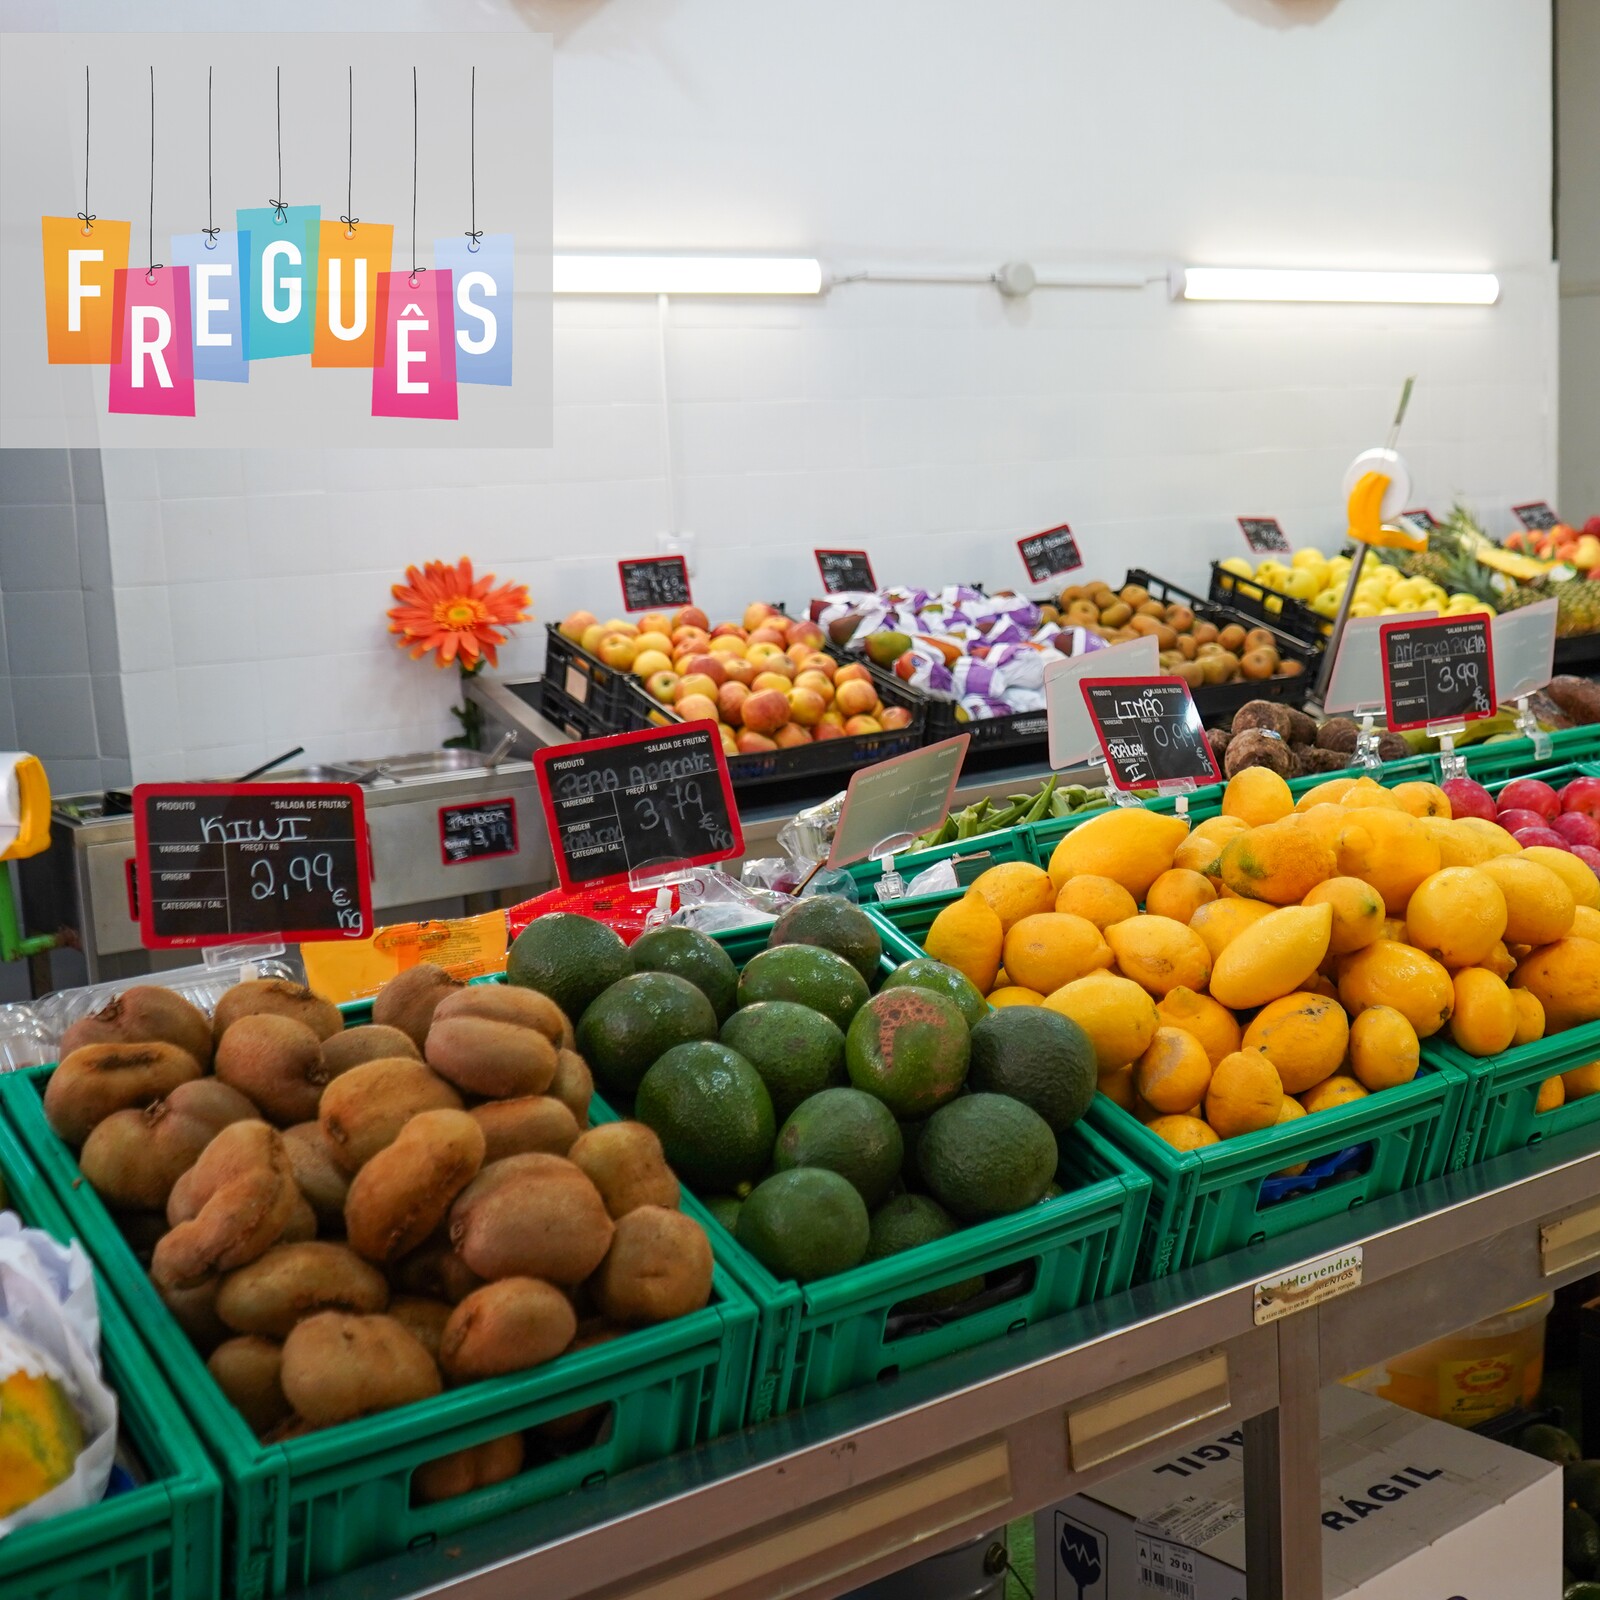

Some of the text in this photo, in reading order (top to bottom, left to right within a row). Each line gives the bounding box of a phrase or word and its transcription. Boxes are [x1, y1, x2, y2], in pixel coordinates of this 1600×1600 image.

[1395, 640, 1450, 662] AMEIXA
[1437, 662, 1479, 693] 3,99
[1114, 689, 1164, 719] LIMÃO
[1153, 721, 1197, 749] 0,99
[675, 740, 682, 748] DE
[553, 758, 585, 771] PRODUTO
[625, 785, 645, 796] PREÇO
[649, 783, 658, 792] KG
[156, 800, 350, 811] PRODUTO "SALADA DE FRUTAS"
[561, 796, 595, 809] VARIEDADE
[634, 780, 705, 837] 3,79
[200, 815, 311, 844] KIWI
[567, 822, 591, 833] ORIGEM
[159, 844, 200, 853] VARIEDADE
[240, 843, 262, 854] PREÇO
[269, 843, 280, 851] KG
[572, 846, 604, 859] CATEGORIA
[161, 872, 190, 881] ORIGEM
[251, 853, 334, 901] 2,99
[332, 888, 350, 906] €
[161, 902, 202, 911] CATEGORIA
[1321, 1466, 1443, 1531] RÁGIL
[1140, 1547, 1147, 1559] A
[1152, 1551, 1165, 1564] XL
